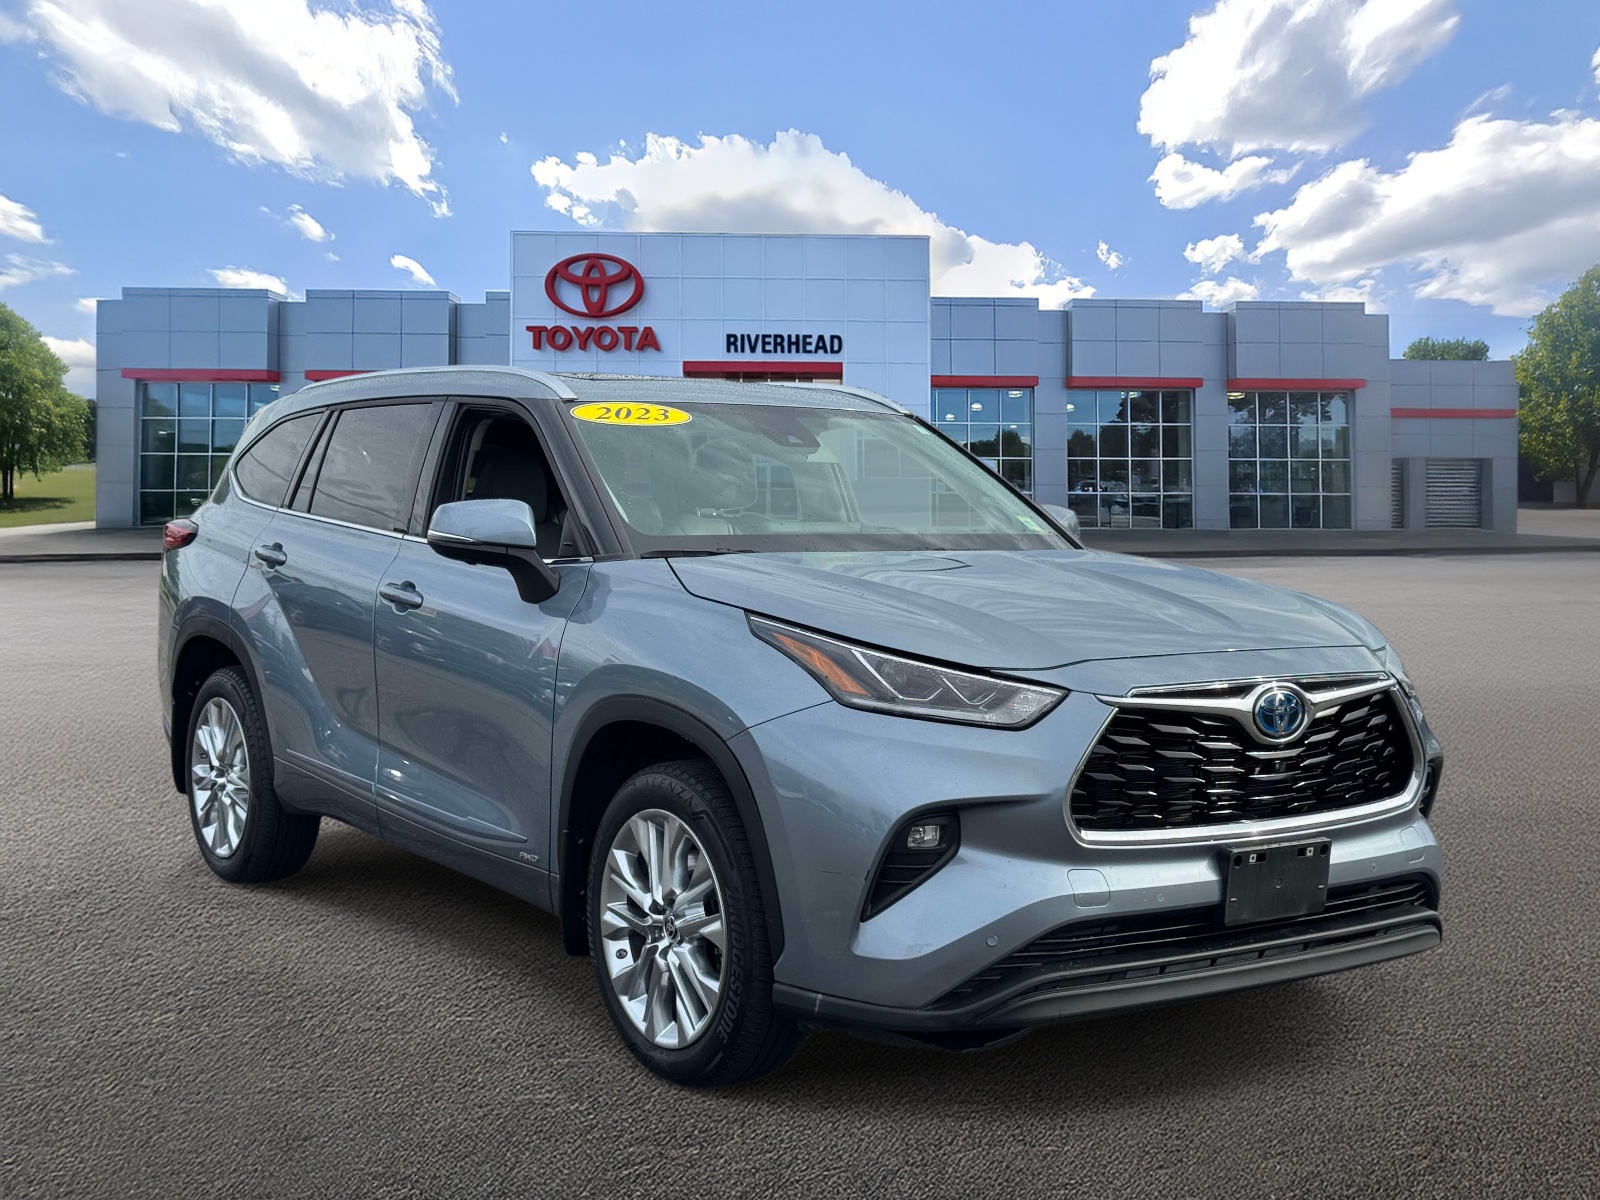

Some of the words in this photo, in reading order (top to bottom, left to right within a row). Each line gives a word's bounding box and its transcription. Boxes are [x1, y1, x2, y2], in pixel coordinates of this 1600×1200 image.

[526, 326, 660, 351] TOYOTA
[725, 333, 843, 355] RIVERHEAD
[595, 407, 669, 420] 2023
